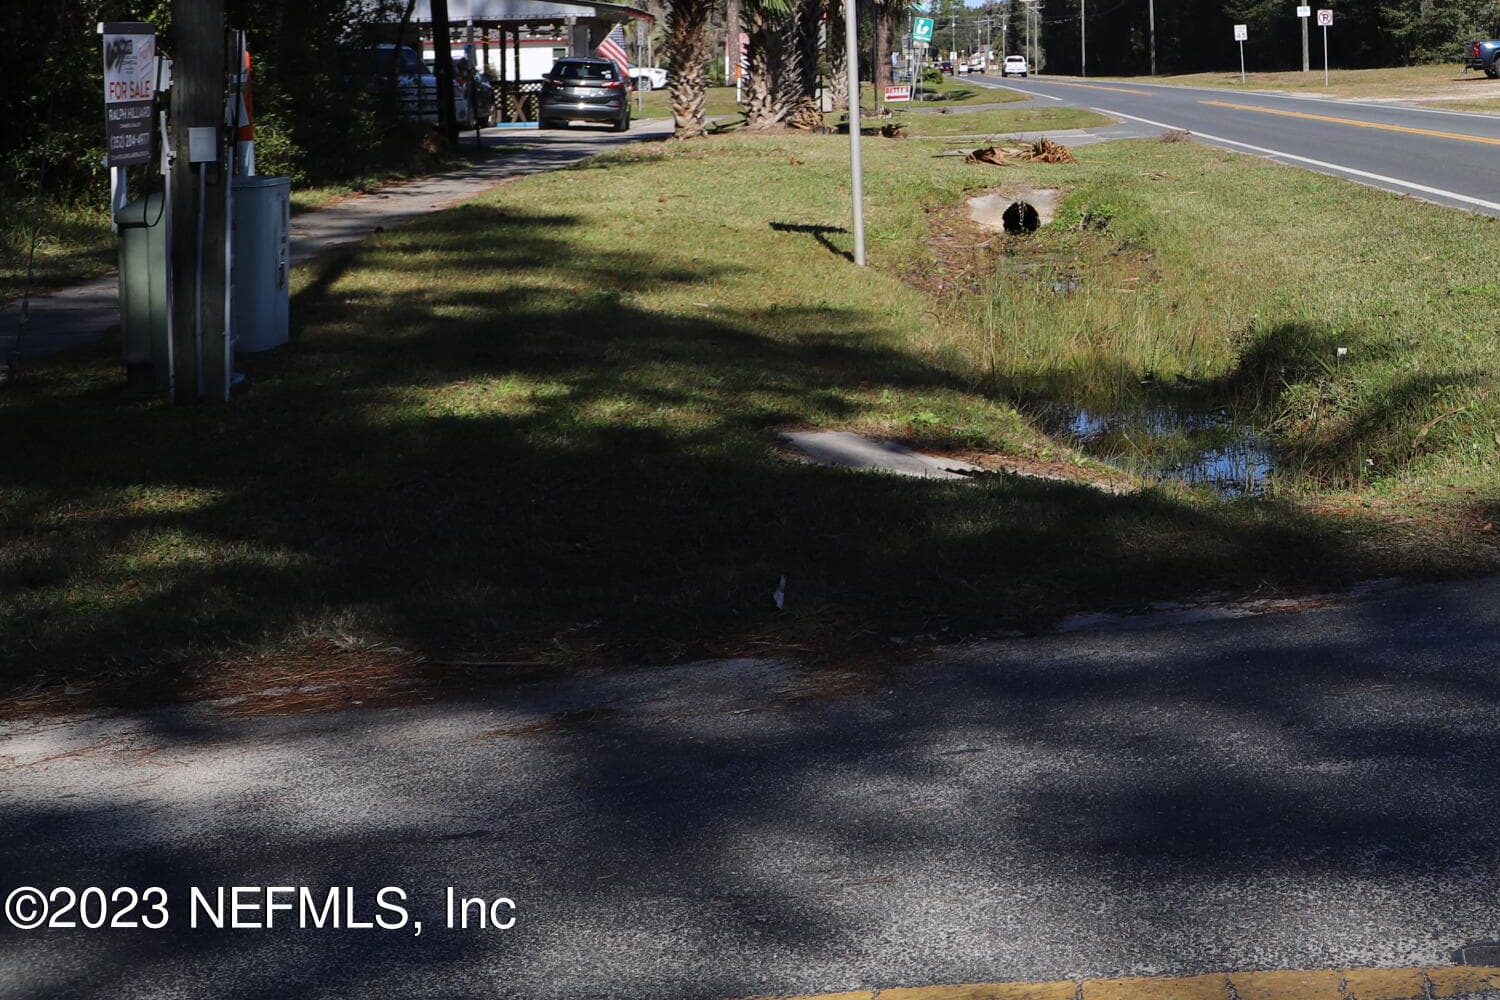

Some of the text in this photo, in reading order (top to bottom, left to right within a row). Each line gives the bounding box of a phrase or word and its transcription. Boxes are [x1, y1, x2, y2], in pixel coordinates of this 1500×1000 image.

[109, 80, 150, 100] FOR SALE
[108, 108, 127, 121] RALPH
